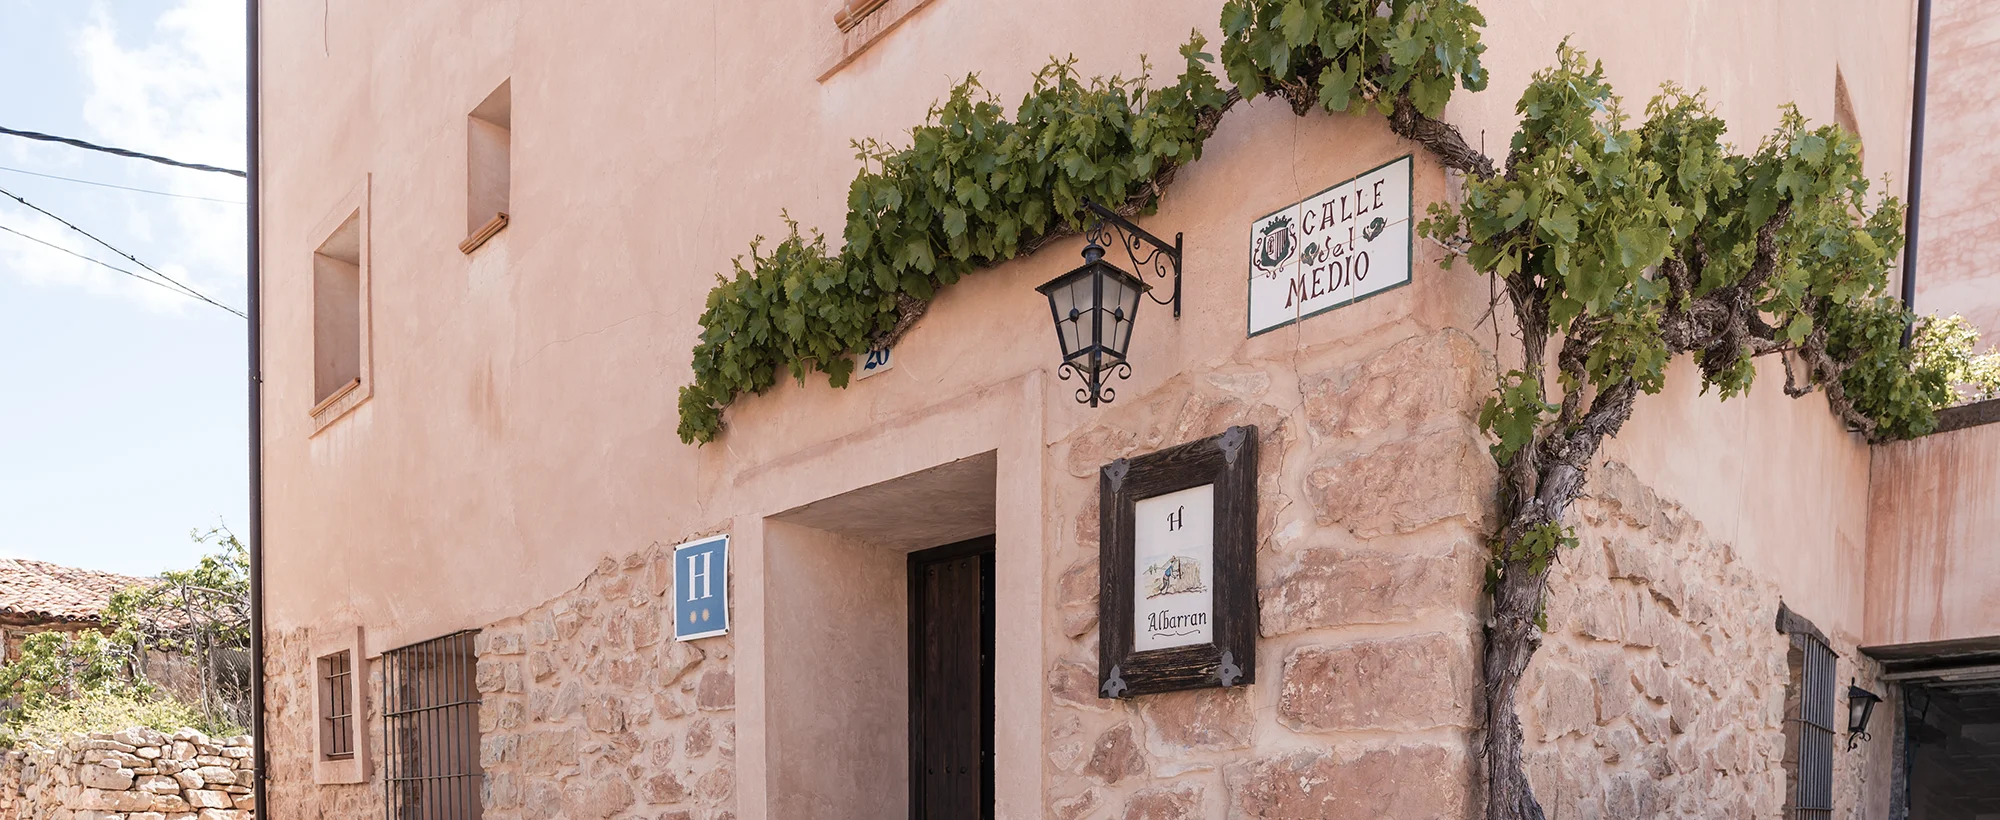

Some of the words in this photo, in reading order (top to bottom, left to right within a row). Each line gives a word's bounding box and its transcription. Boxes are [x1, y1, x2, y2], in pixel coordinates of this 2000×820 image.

[1303, 179, 1384, 235] CALLE
[1285, 251, 1370, 309] MEDIO
[1167, 505, 1184, 532] H
[686, 551, 713, 602] H
[1147, 610, 1207, 632] Albarran
